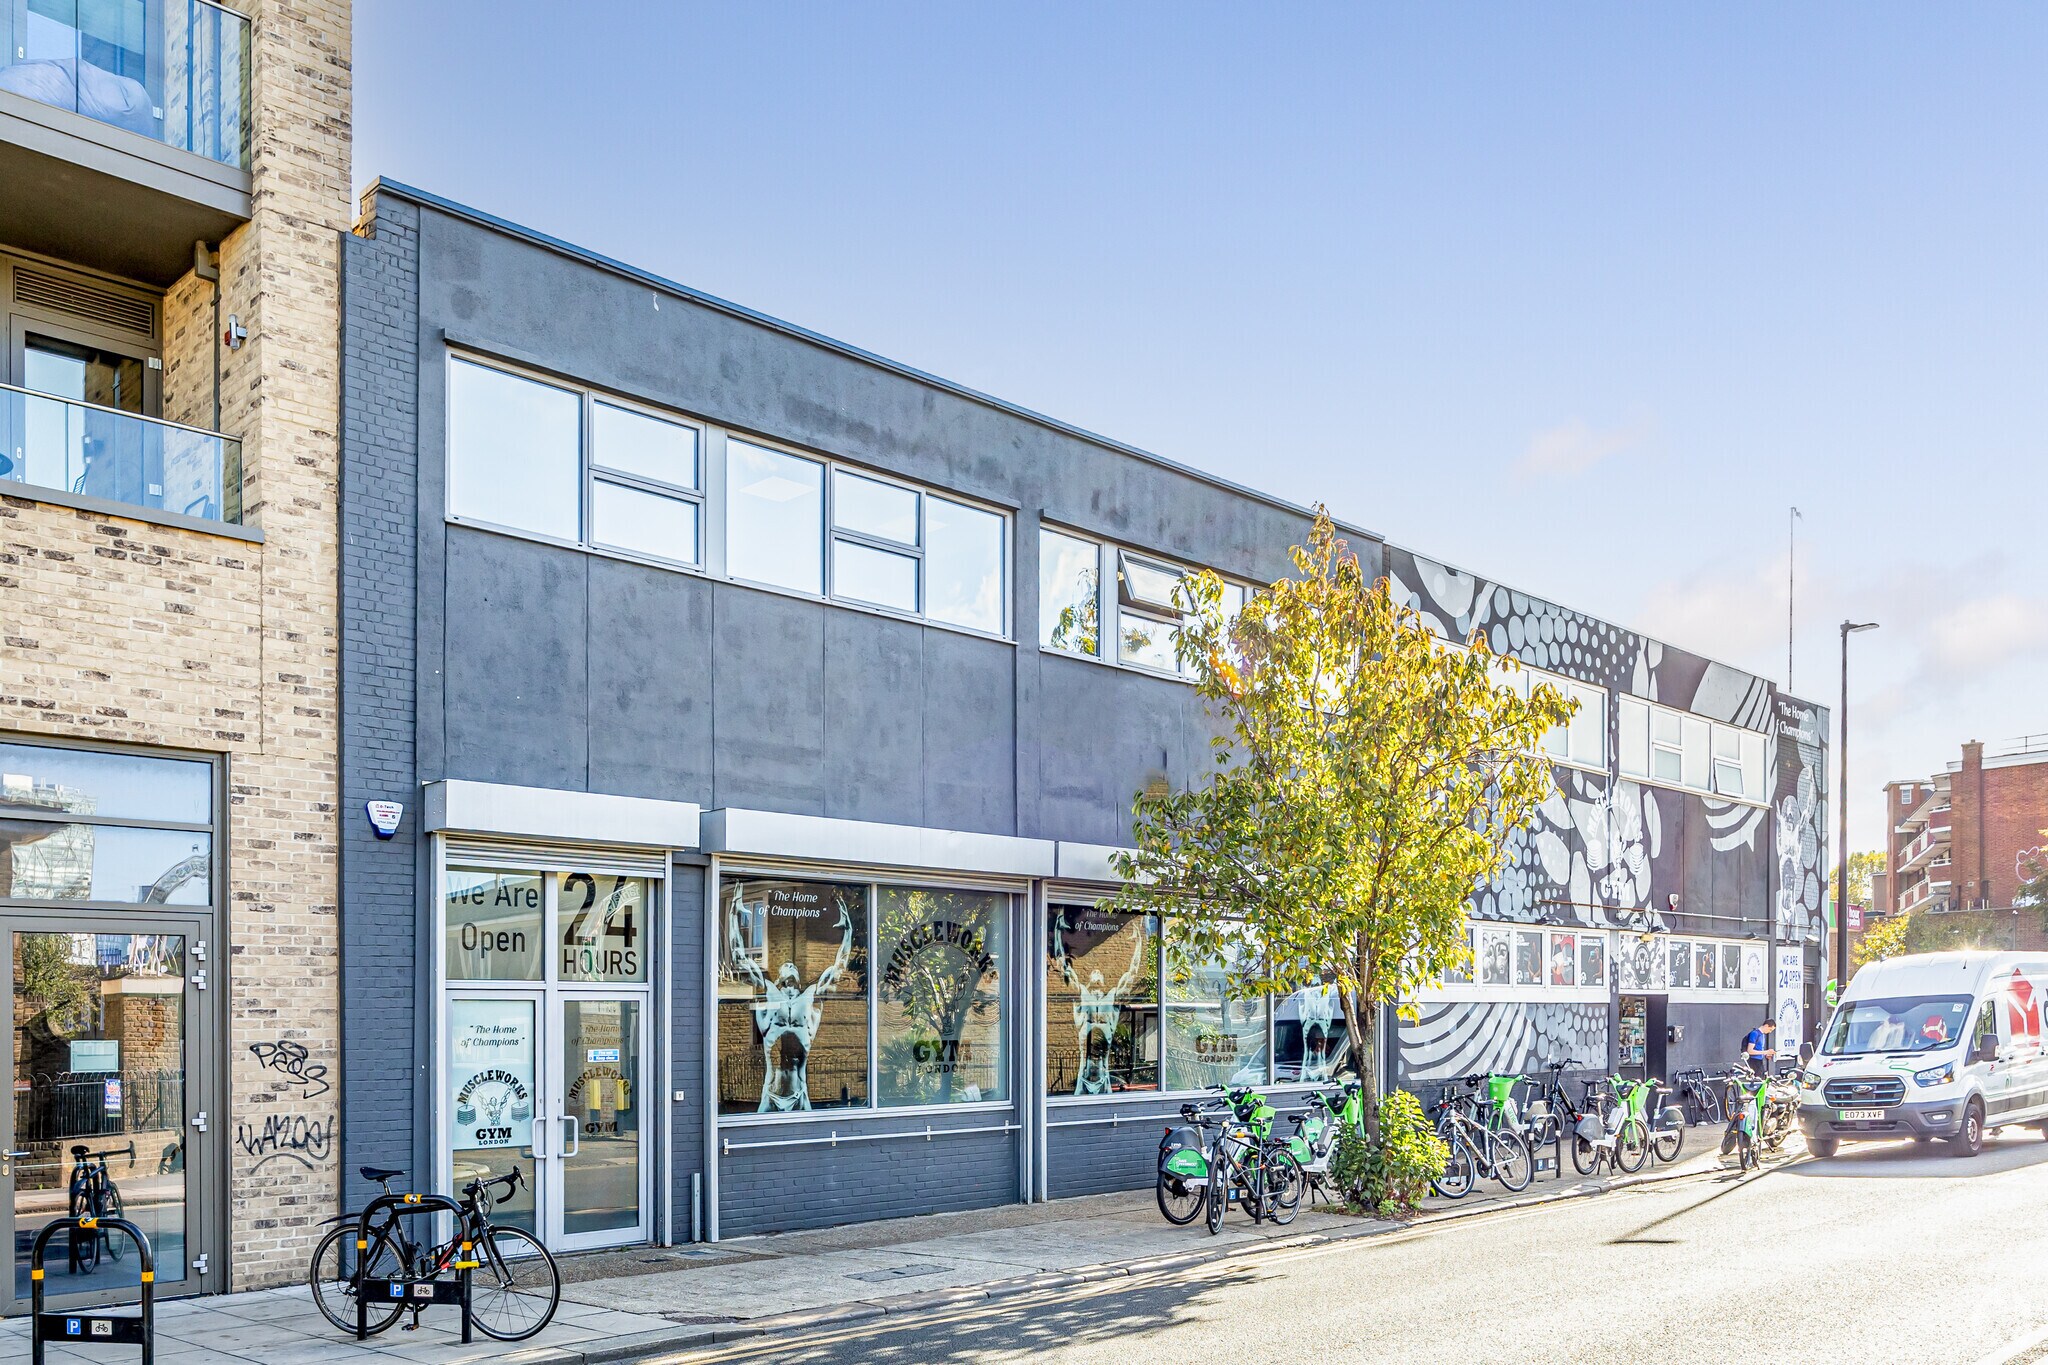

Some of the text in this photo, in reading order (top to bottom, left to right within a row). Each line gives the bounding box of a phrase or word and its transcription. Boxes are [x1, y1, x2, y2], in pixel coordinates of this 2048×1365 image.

[1792, 705, 1809, 722] Home
[448, 877, 539, 909] We Are
[774, 890, 818, 903] The Home
[563, 872, 637, 948] 24
[758, 904, 820, 919] of Champions
[1086, 910, 1118, 919] The Hoe
[1074, 920, 1119, 933] of Champions
[461, 922, 526, 959] Open
[563, 948, 637, 976] HOURS
[1782, 955, 1798, 966] WE ARE
[1779, 969, 1789, 989] 24
[1789, 970, 1801, 982] OPEN
[475, 1025, 517, 1034] The Home
[460, 1038, 519, 1048] of Champions
[571, 1036, 581, 1046] of
[1784, 1039, 1796, 1047] GYM
[913, 1039, 972, 1063] GYM
[917, 1063, 967, 1074] LONDON
[457, 1069, 528, 1105] MUSCLEWORKS
[568, 1066, 632, 1100] MUSCLEWORKS
[1867, 1110, 1882, 1119] XVF
[475, 1127, 512, 1140] GYM
[585, 1121, 618, 1134] GYM
